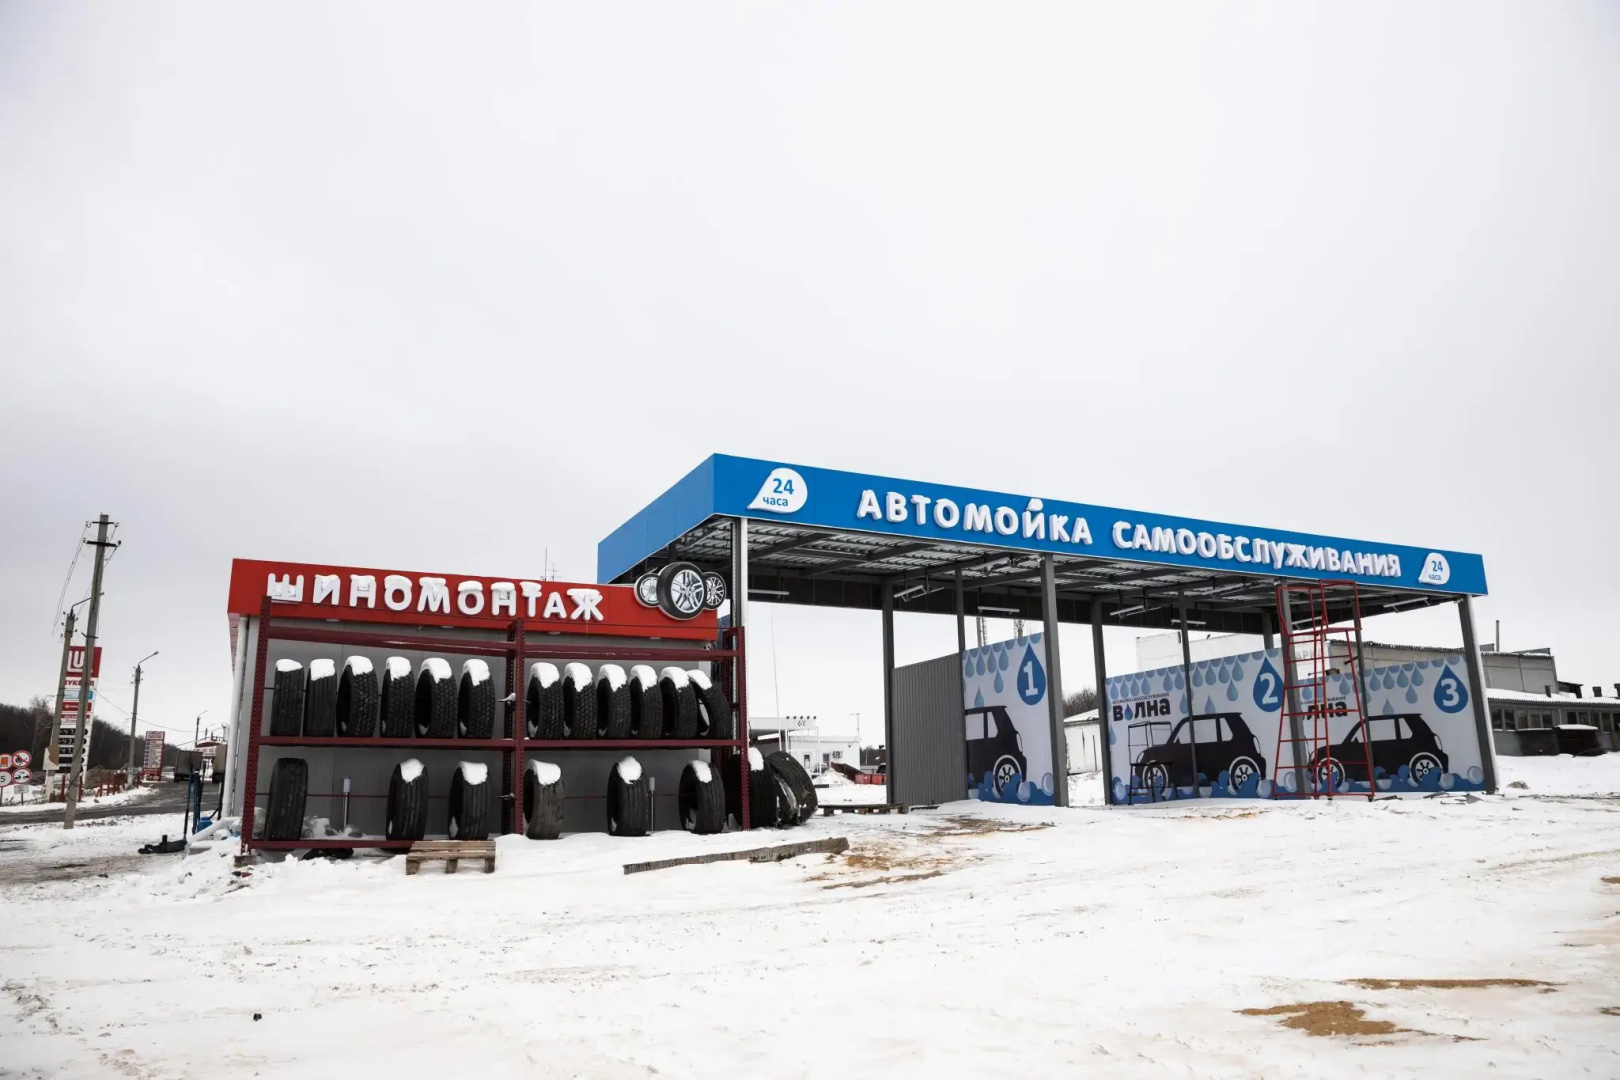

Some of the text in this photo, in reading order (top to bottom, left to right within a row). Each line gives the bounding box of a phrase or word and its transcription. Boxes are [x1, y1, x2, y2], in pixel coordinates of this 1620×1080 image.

[762, 496, 789, 507] часа
[773, 478, 794, 495] 24
[857, 489, 1401, 577] АВТОМОЙКА САМООБСЛУЖИВАНИЯ
[1431, 560, 1443, 572] 24
[267, 573, 604, 621] ШИНОМОНТАЖ
[1023, 660, 1039, 697] 1
[1260, 672, 1278, 705] 2
[1440, 678, 1460, 707] 3
